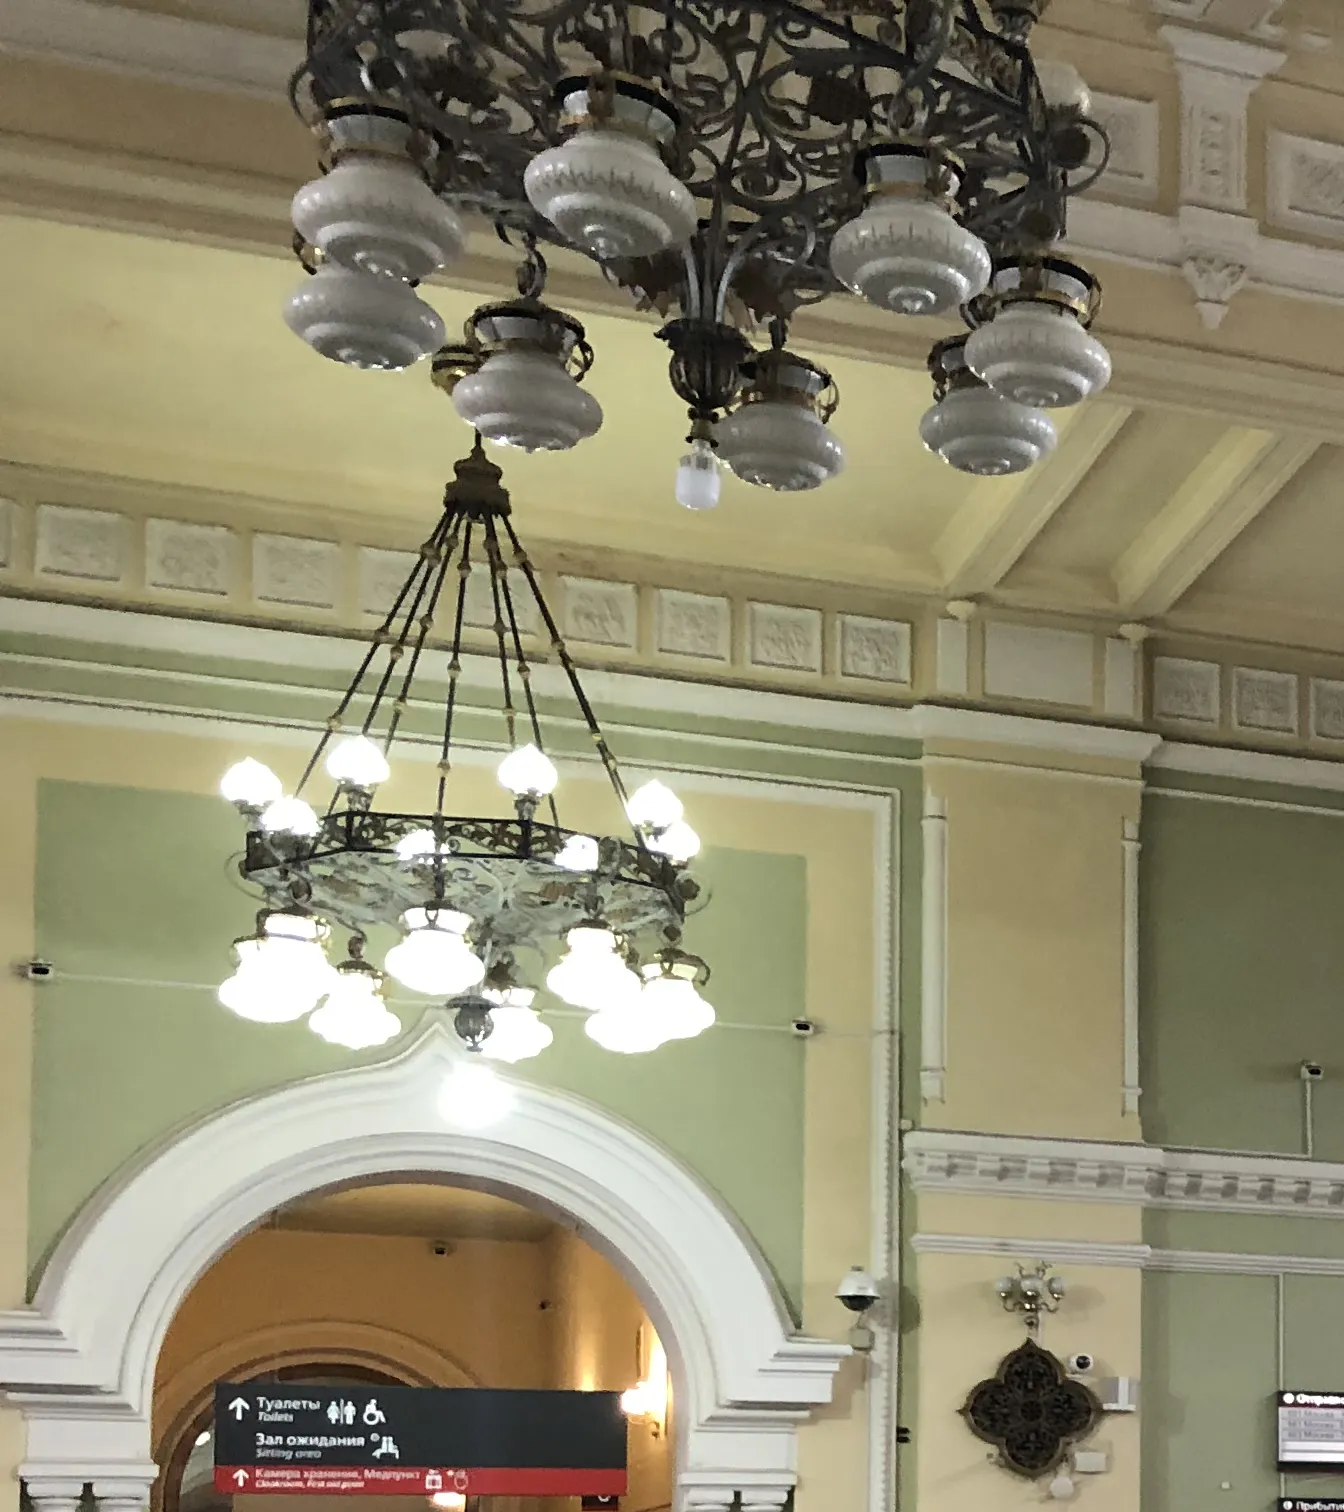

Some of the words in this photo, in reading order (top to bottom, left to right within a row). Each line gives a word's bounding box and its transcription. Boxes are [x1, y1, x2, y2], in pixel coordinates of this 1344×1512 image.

[257, 1396, 321, 1412] Туалеты
[258, 1411, 294, 1422] Toilets
[256, 1432, 283, 1446] Зал
[286, 1435, 366, 1448] ожидания
[364, 1469, 421, 1481] Медпункт
